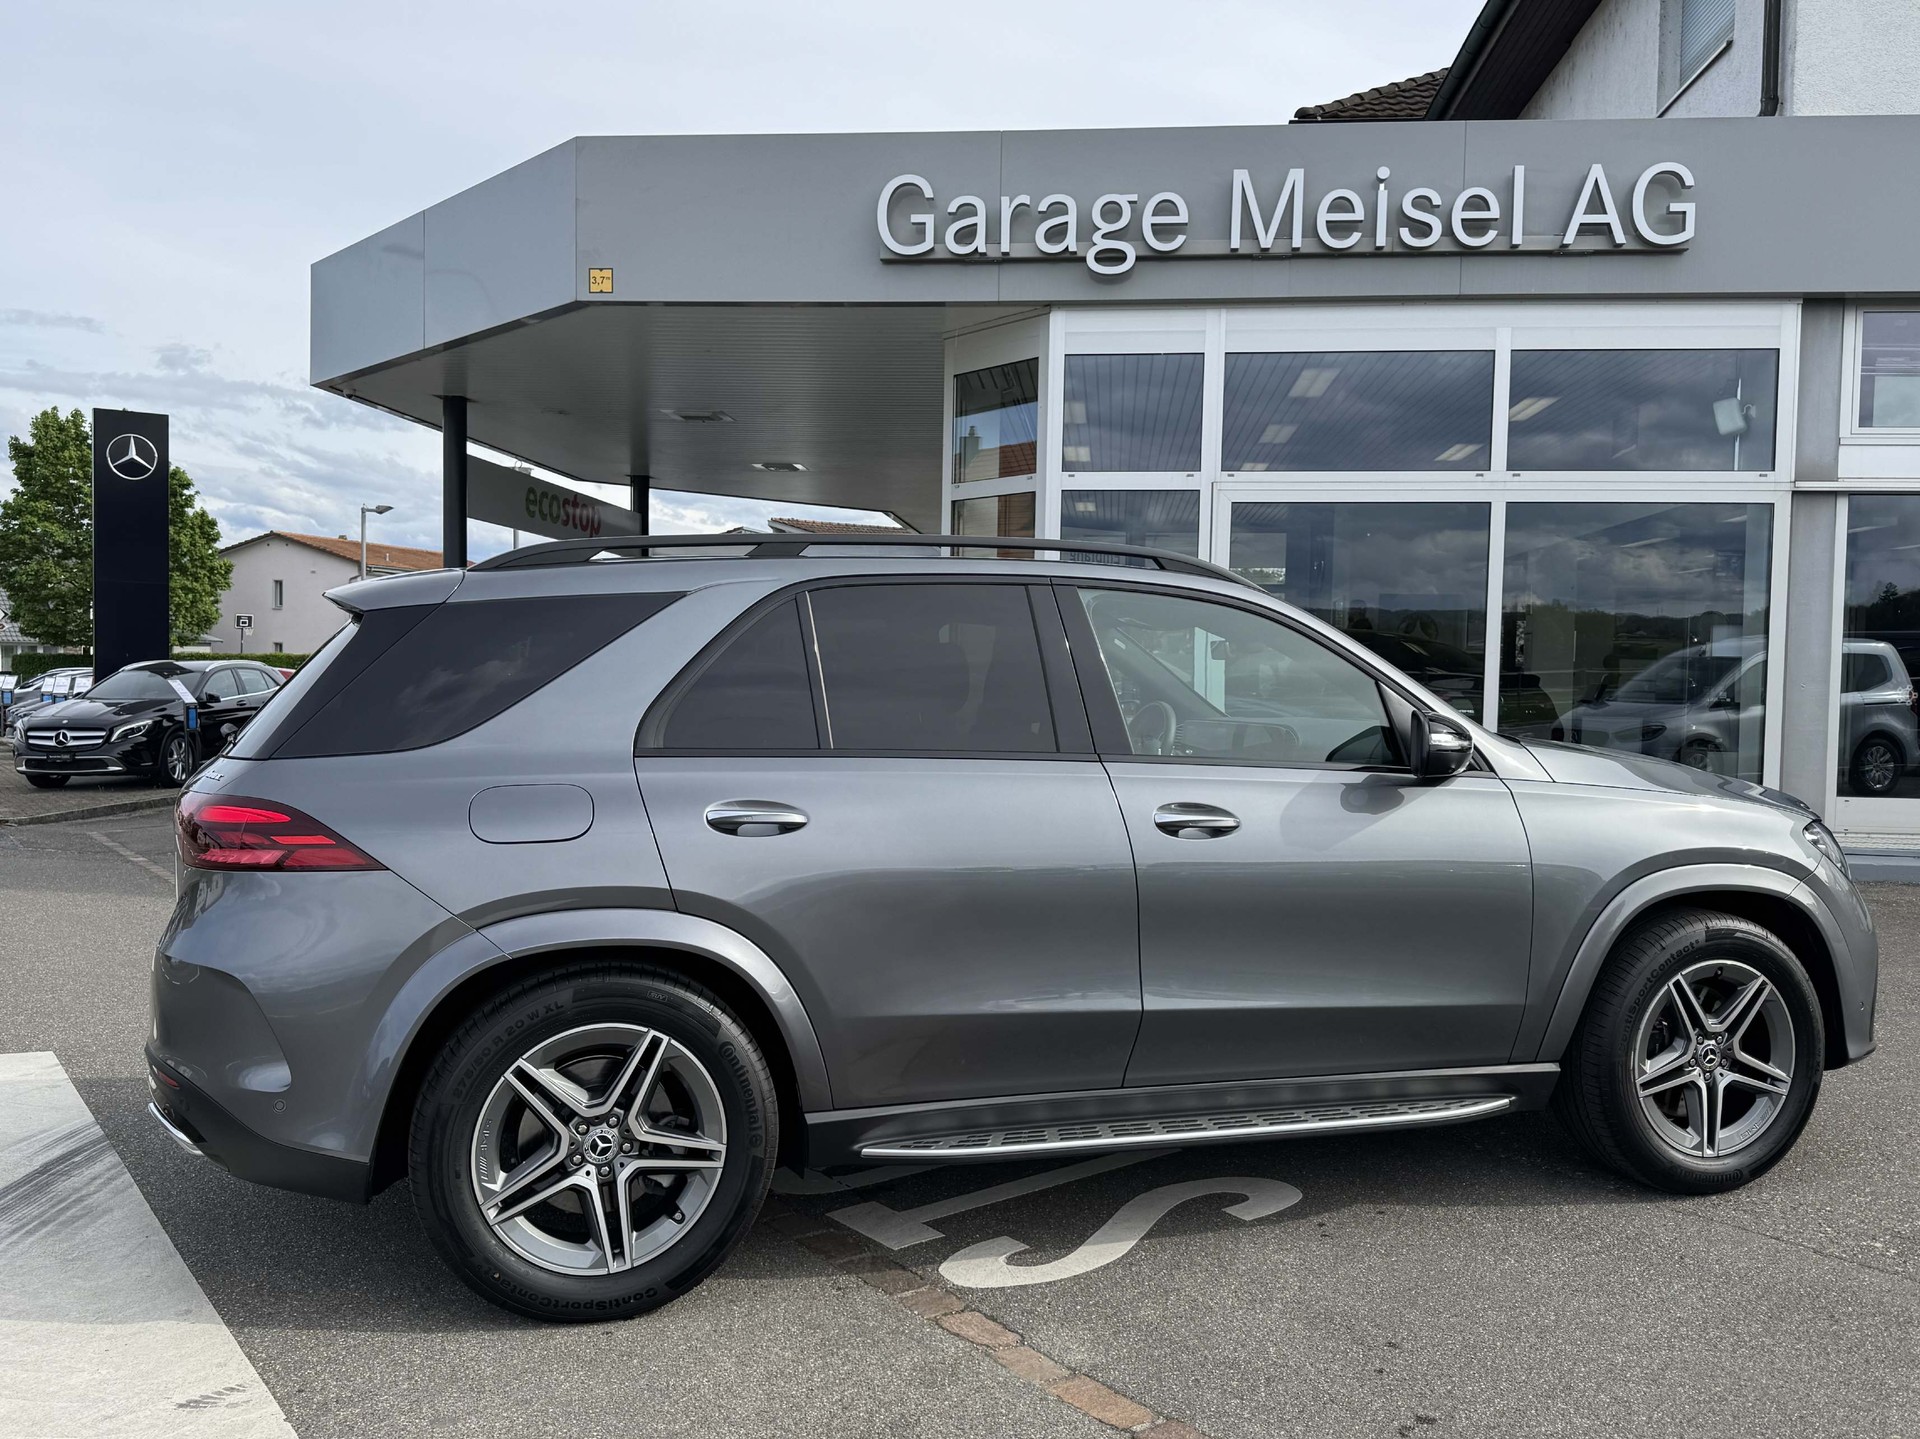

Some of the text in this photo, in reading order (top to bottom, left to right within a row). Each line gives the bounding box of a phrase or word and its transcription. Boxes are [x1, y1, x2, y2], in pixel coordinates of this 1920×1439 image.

[876, 161, 1697, 277] Garage Meisel AG
[525, 486, 602, 538] ecostop
[506, 1019, 525, 1037] 20
[527, 1010, 539, 1021] W
[544, 1001, 564, 1014] XL
[720, 1041, 763, 1132] Continental
